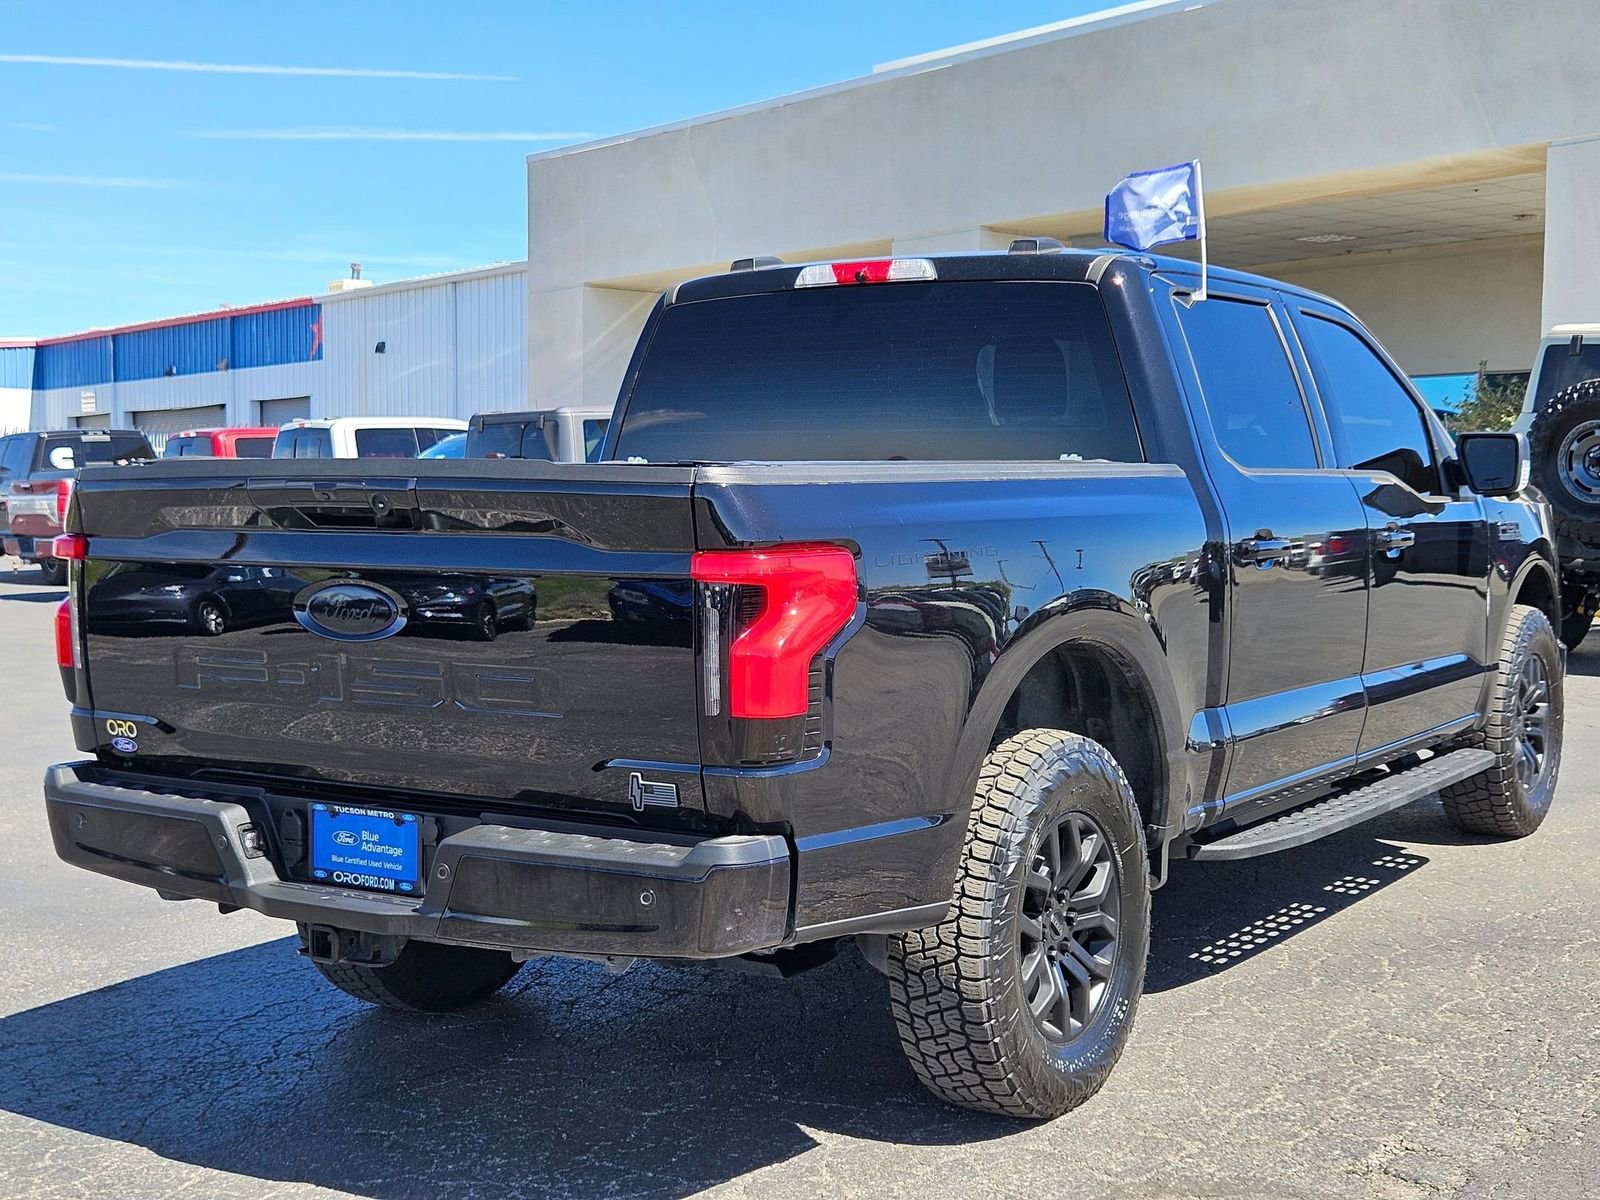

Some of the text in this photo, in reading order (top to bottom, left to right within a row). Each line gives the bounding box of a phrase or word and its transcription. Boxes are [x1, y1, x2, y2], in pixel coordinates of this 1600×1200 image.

[323, 598, 378, 623] Ford
[175, 644, 564, 718] F-150
[106, 719, 138, 738] ORO
[334, 805, 366, 816] TUCSON
[367, 809, 395, 819] METRO
[336, 831, 356, 844] Ford
[361, 830, 380, 842] Blue
[361, 842, 403, 857] Advantage
[331, 854, 403, 871] Blue Certified Used Vehicle
